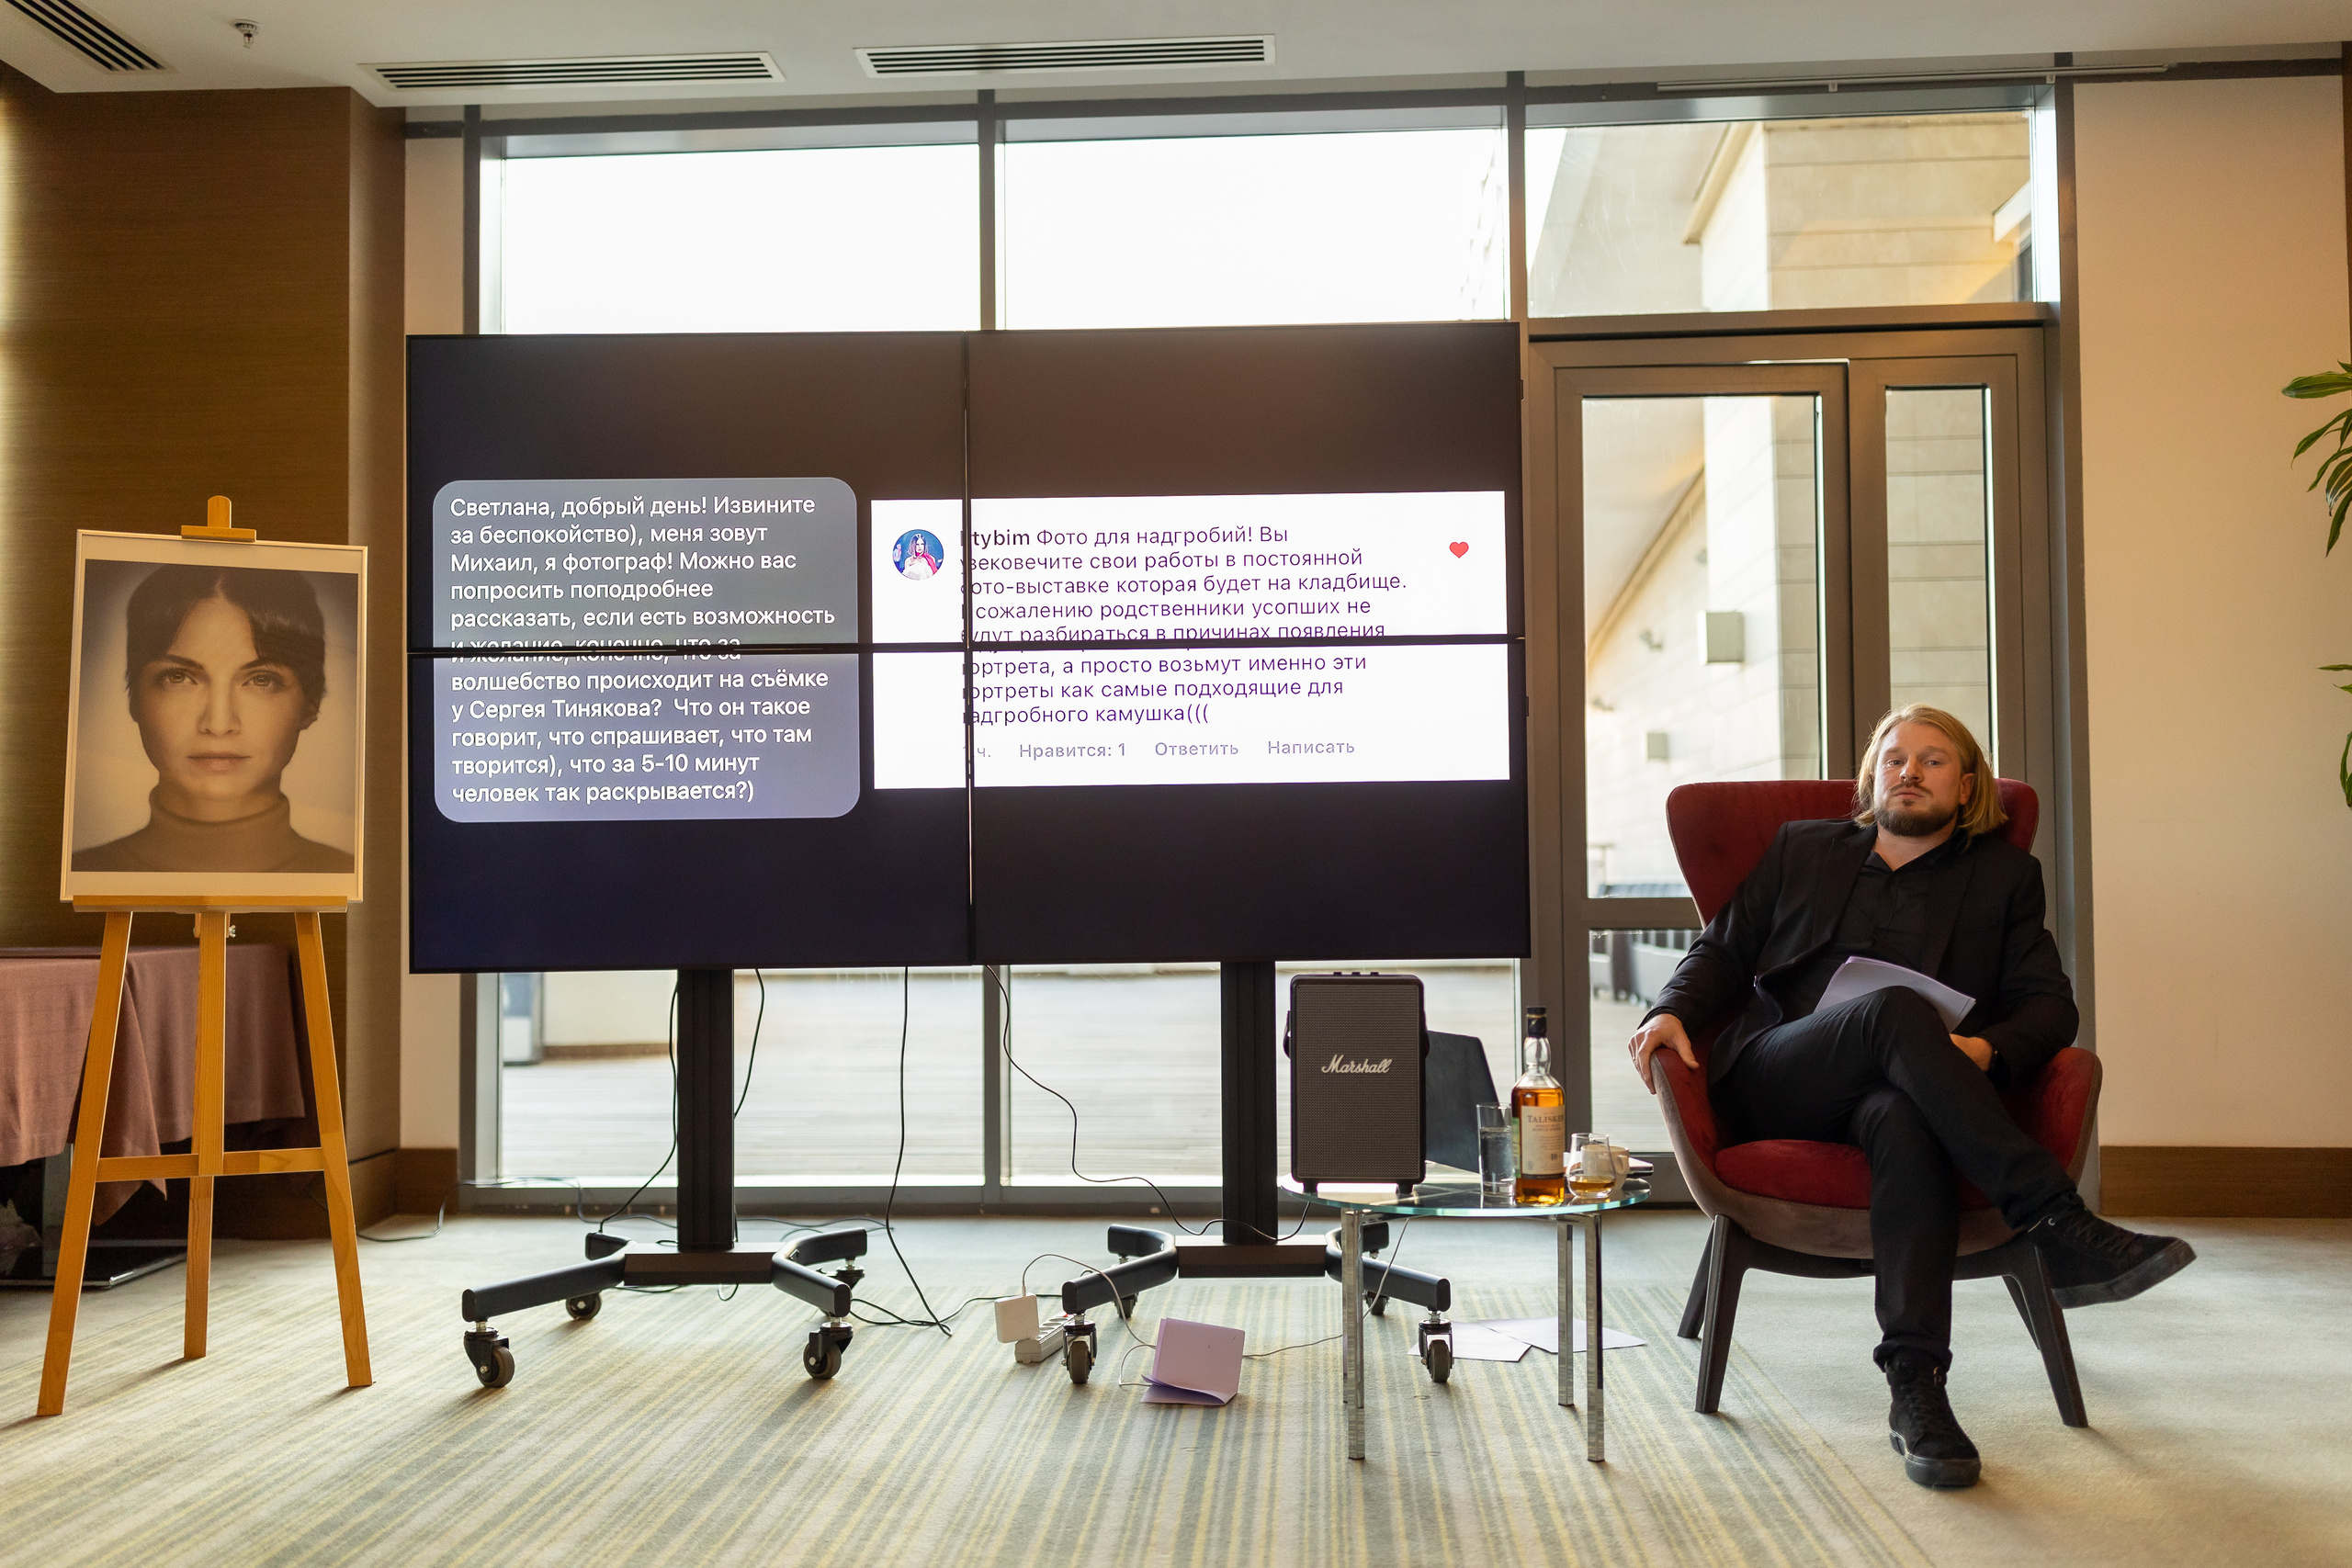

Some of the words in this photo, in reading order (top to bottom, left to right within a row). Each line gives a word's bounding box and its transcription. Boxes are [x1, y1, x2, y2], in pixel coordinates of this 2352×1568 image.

[450, 498, 556, 520] Светлана,
[561, 495, 644, 519] добрый
[650, 496, 707, 518] день!
[714, 496, 816, 514] Извините
[450, 530, 473, 545] за
[480, 524, 643, 547] беспокойство),
[650, 527, 703, 543] меня
[709, 527, 768, 546] зовут
[1036, 528, 1088, 546] Фото
[1093, 532, 1130, 547] для
[1136, 525, 1252, 547] надгробий!
[1260, 525, 1288, 542] Вы
[451, 553, 538, 575] Михаил,
[544, 557, 556, 571] я
[562, 551, 673, 575] фотограф!
[680, 551, 754, 570] Можно
[761, 555, 797, 569] вас
[1090, 556, 1137, 570] свои
[1145, 550, 1218, 572] работы
[1226, 554, 1237, 568] в
[1243, 547, 1363, 567] постоянной
[451, 584, 564, 604] попросить
[571, 579, 714, 602] поподробнее
[1116, 579, 1197, 596] которая
[1204, 574, 1261, 595] будет
[1268, 577, 1291, 591] на
[1298, 572, 1407, 592] кладбище.
[451, 612, 576, 632] рассказать,
[582, 611, 634, 626] если
[639, 611, 687, 626] есть
[693, 609, 835, 626] возможность
[975, 604, 1093, 619] сожалению
[1100, 603, 1244, 621] родственники
[1251, 601, 1340, 619] усопших
[1347, 601, 1371, 615] не
[1019, 624, 1150, 650] разбираться
[1154, 626, 1167, 640] в
[1171, 623, 1272, 650] причинах
[1276, 622, 1385, 639] появления
[1062, 660, 1073, 674] а
[1080, 660, 1152, 677] просто
[1159, 659, 1242, 675] возьмут
[1249, 657, 1326, 671] именно
[1332, 657, 1366, 671] эти
[451, 671, 581, 691] волшебство
[587, 673, 714, 694] происходит
[719, 673, 744, 688] на
[750, 668, 829, 688] съёмке
[1061, 684, 1094, 698] как
[1101, 683, 1168, 698] самые
[1174, 682, 1302, 699] подходящие
[1307, 682, 1343, 698] для
[451, 704, 464, 723] у
[469, 700, 546, 723] Сергея
[551, 698, 662, 717] Тинякова?
[673, 698, 713, 716] Что
[718, 701, 744, 716] он
[750, 700, 810, 716] такое
[1096, 703, 1209, 726] камушка(((
[452, 731, 542, 750] говорит,
[548, 730, 584, 746] что
[590, 729, 724, 749] спрашивает,
[730, 728, 767, 743] что
[772, 728, 812, 743] там
[1020, 744, 1112, 761] Нравится:
[1117, 742, 1125, 758] 1
[1155, 741, 1238, 756] Ответить
[1268, 740, 1355, 754] Написать
[451, 754, 562, 779] творится),
[570, 758, 605, 773] что
[611, 758, 635, 773] за
[641, 753, 689, 773] 5-10
[695, 756, 761, 775] минут
[452, 786, 539, 803] человек
[544, 786, 581, 802] так
[586, 780, 754, 806] раскрывается?)
[1320, 1054, 1394, 1075] Marshall
